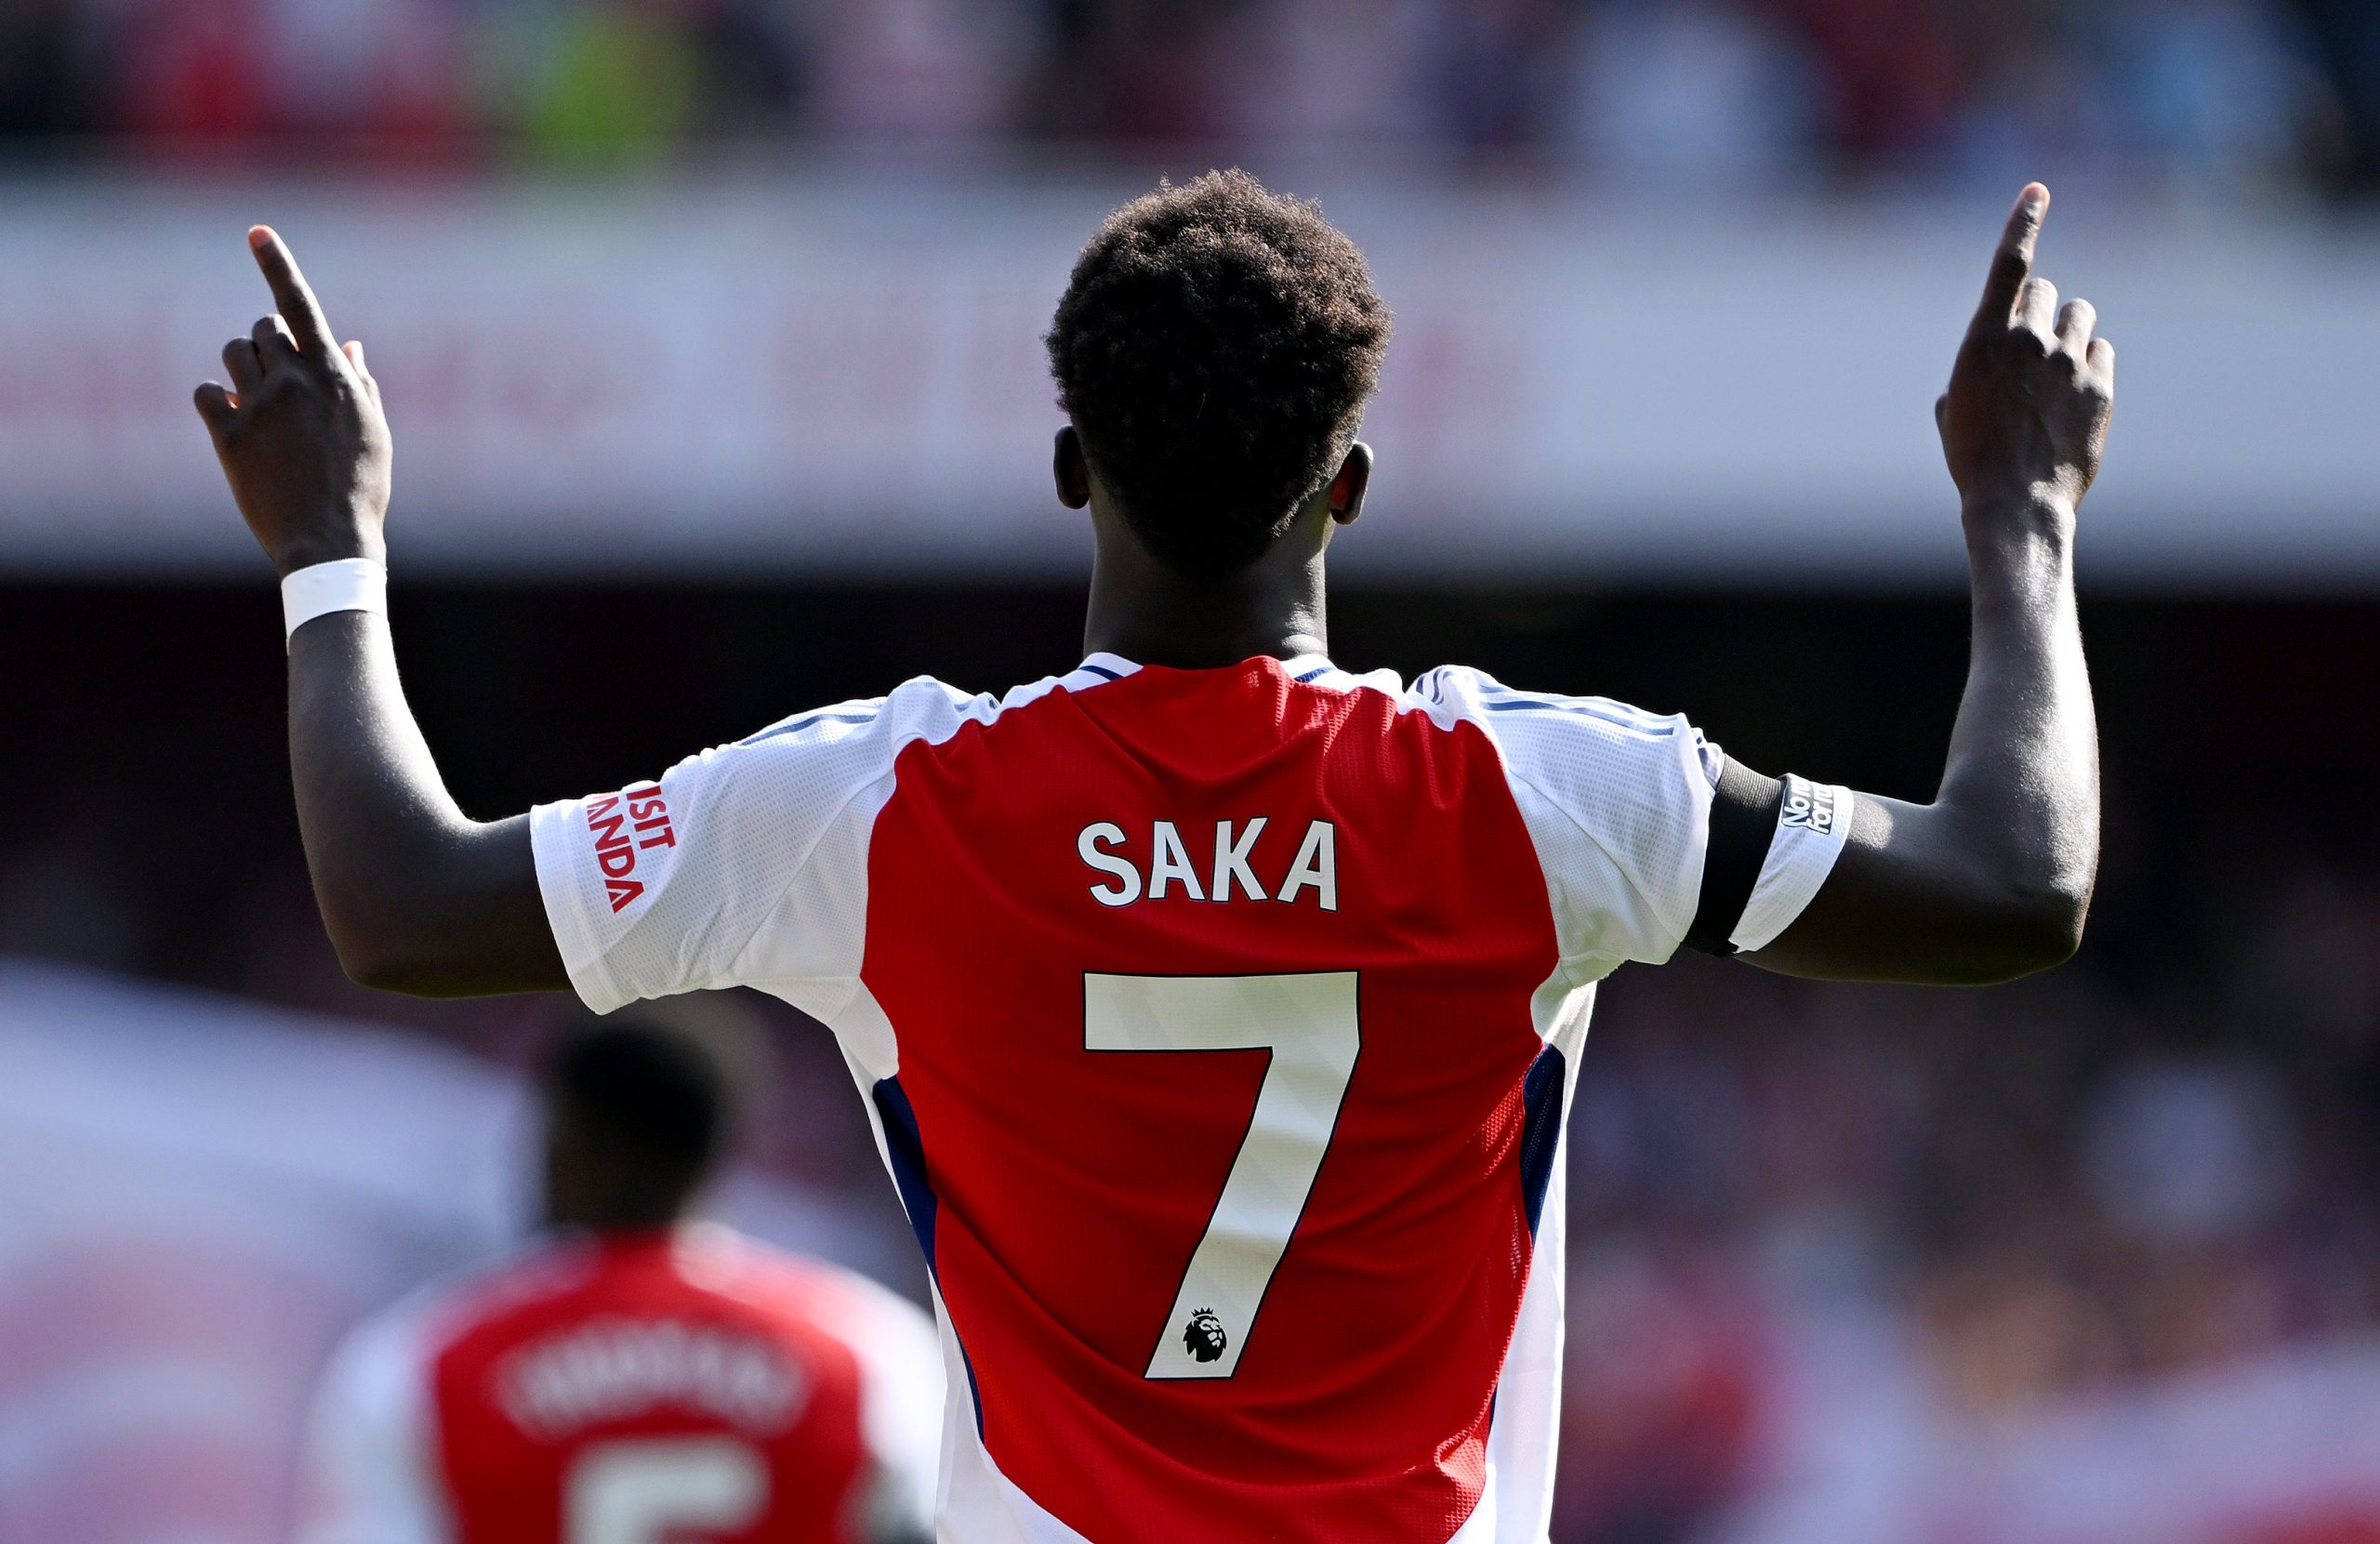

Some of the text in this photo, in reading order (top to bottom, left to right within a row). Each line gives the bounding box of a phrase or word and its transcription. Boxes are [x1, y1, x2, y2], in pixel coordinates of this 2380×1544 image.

[586, 794, 645, 915] ANDA
[627, 785, 676, 850] ISIT
[1782, 797, 1810, 826] No
[1077, 816, 1338, 913] SAKA
[1083, 970, 1361, 1380] 7
